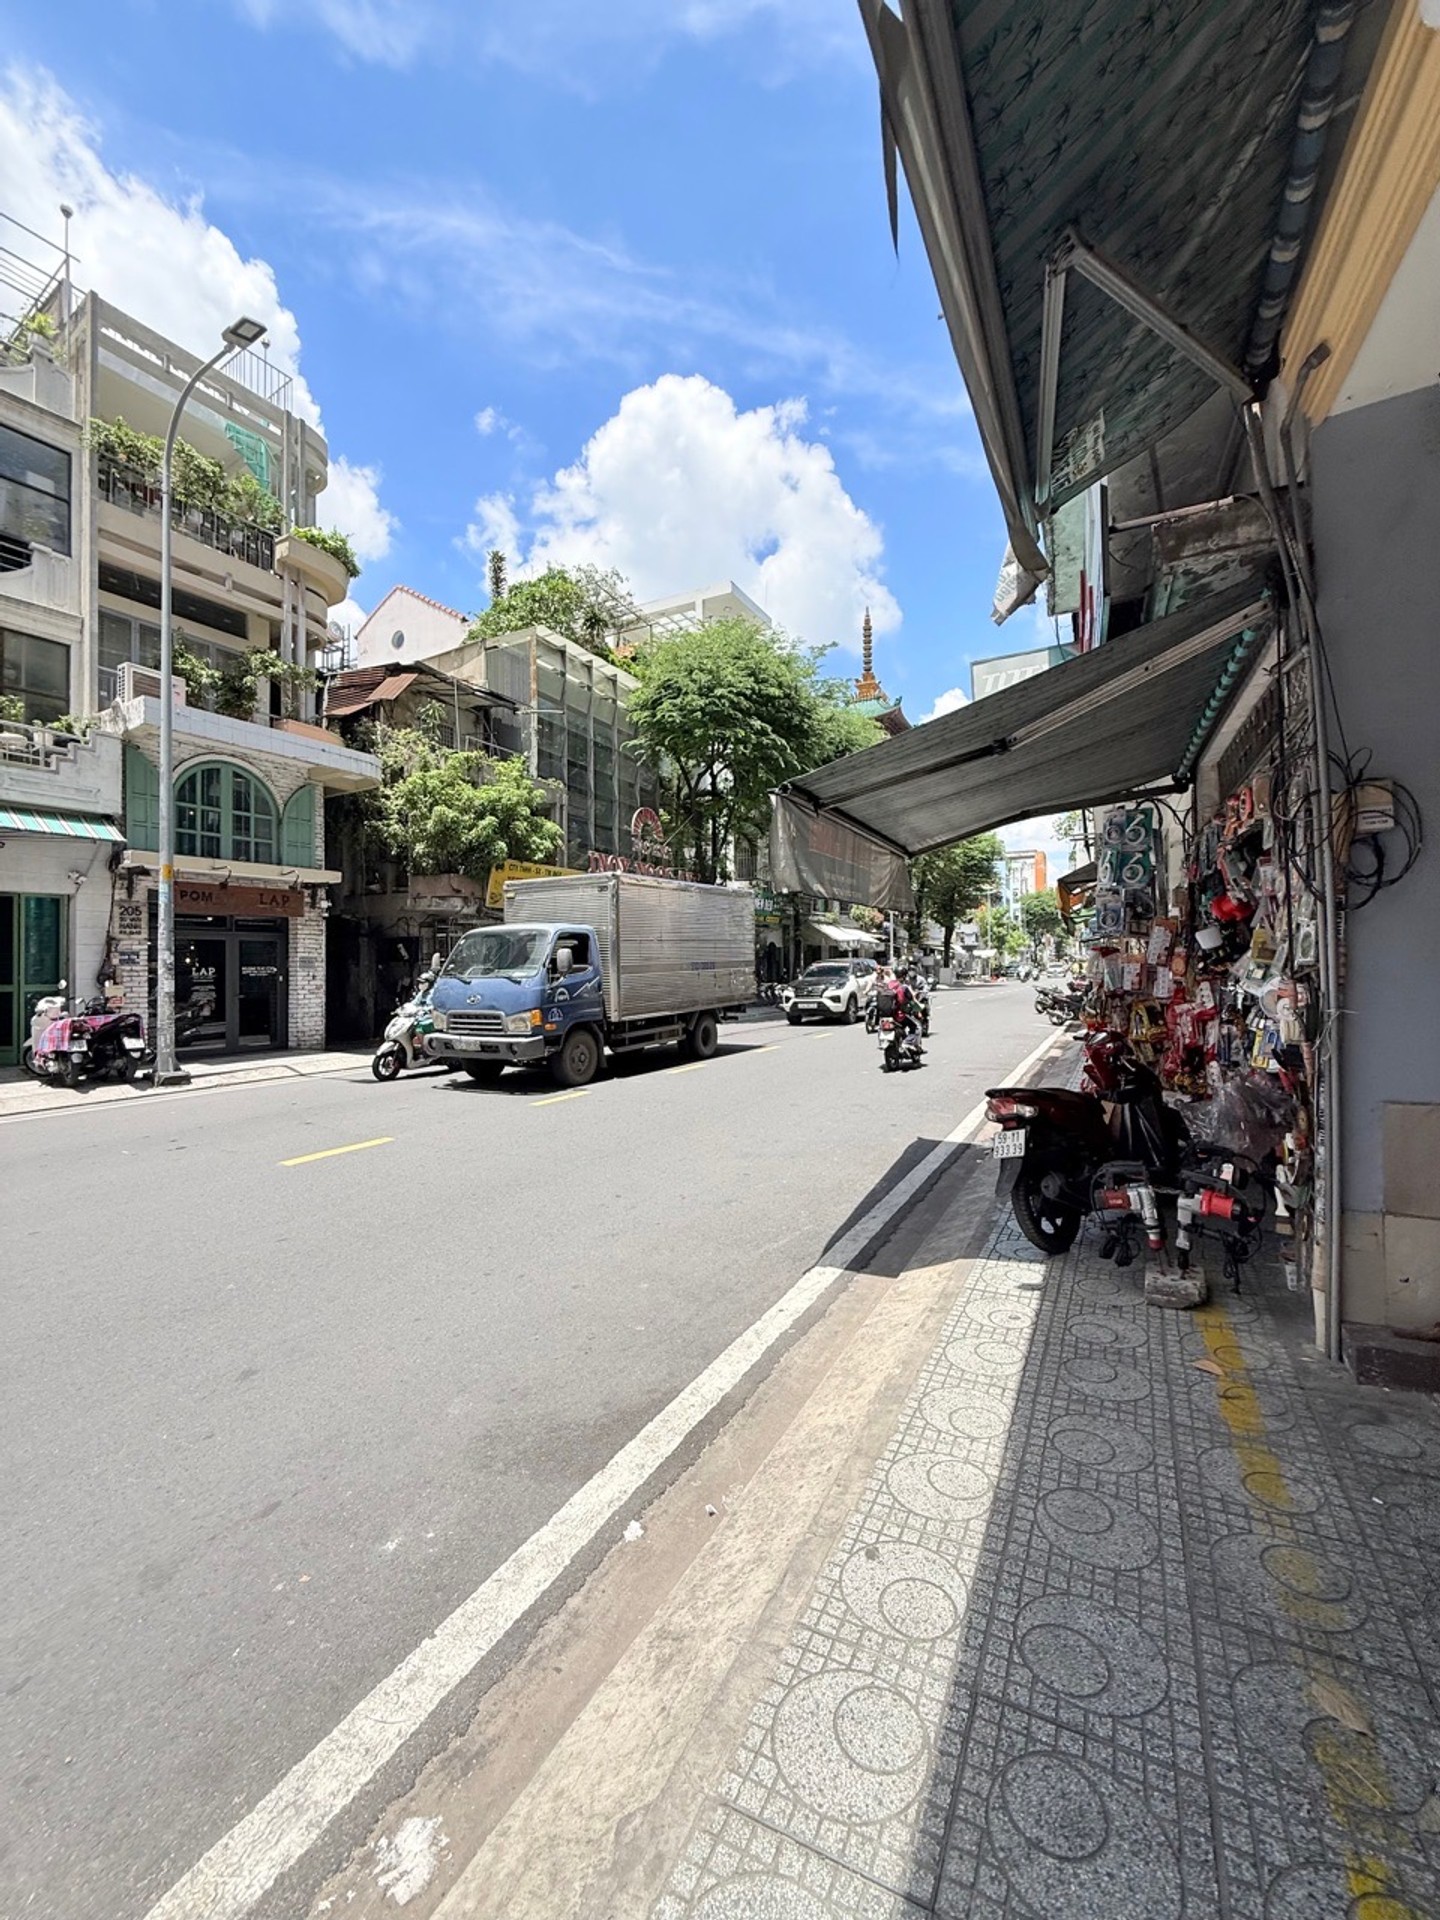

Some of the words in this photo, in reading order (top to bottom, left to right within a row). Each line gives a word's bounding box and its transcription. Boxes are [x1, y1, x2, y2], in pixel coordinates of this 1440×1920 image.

[179, 889, 213, 903] POM
[258, 893, 290, 907] LAP
[118, 905, 142, 916] 205
[191, 967, 216, 976] LAP
